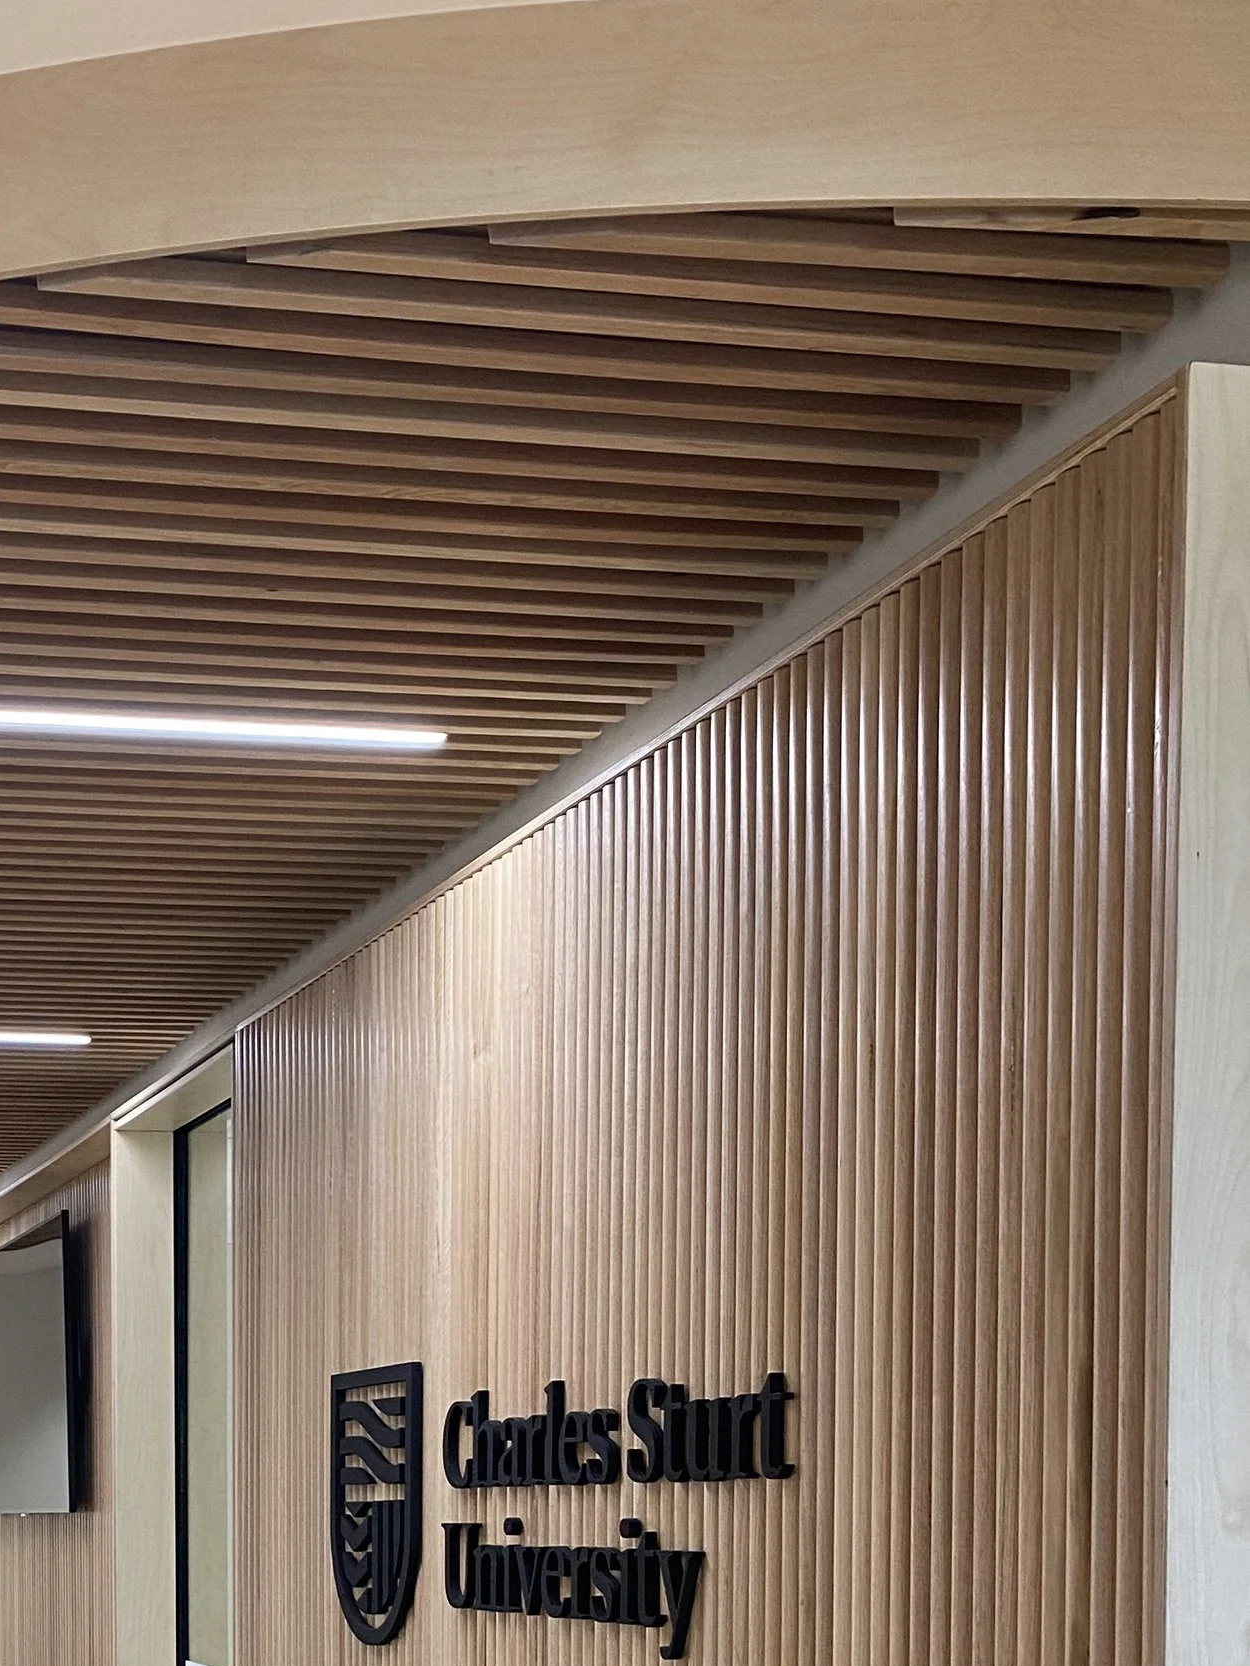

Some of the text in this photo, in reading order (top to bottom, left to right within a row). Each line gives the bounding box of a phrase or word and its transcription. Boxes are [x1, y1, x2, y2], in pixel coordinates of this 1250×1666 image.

[442, 1372, 796, 1489] Charles Sturt
[441, 1517, 707, 1660] University
